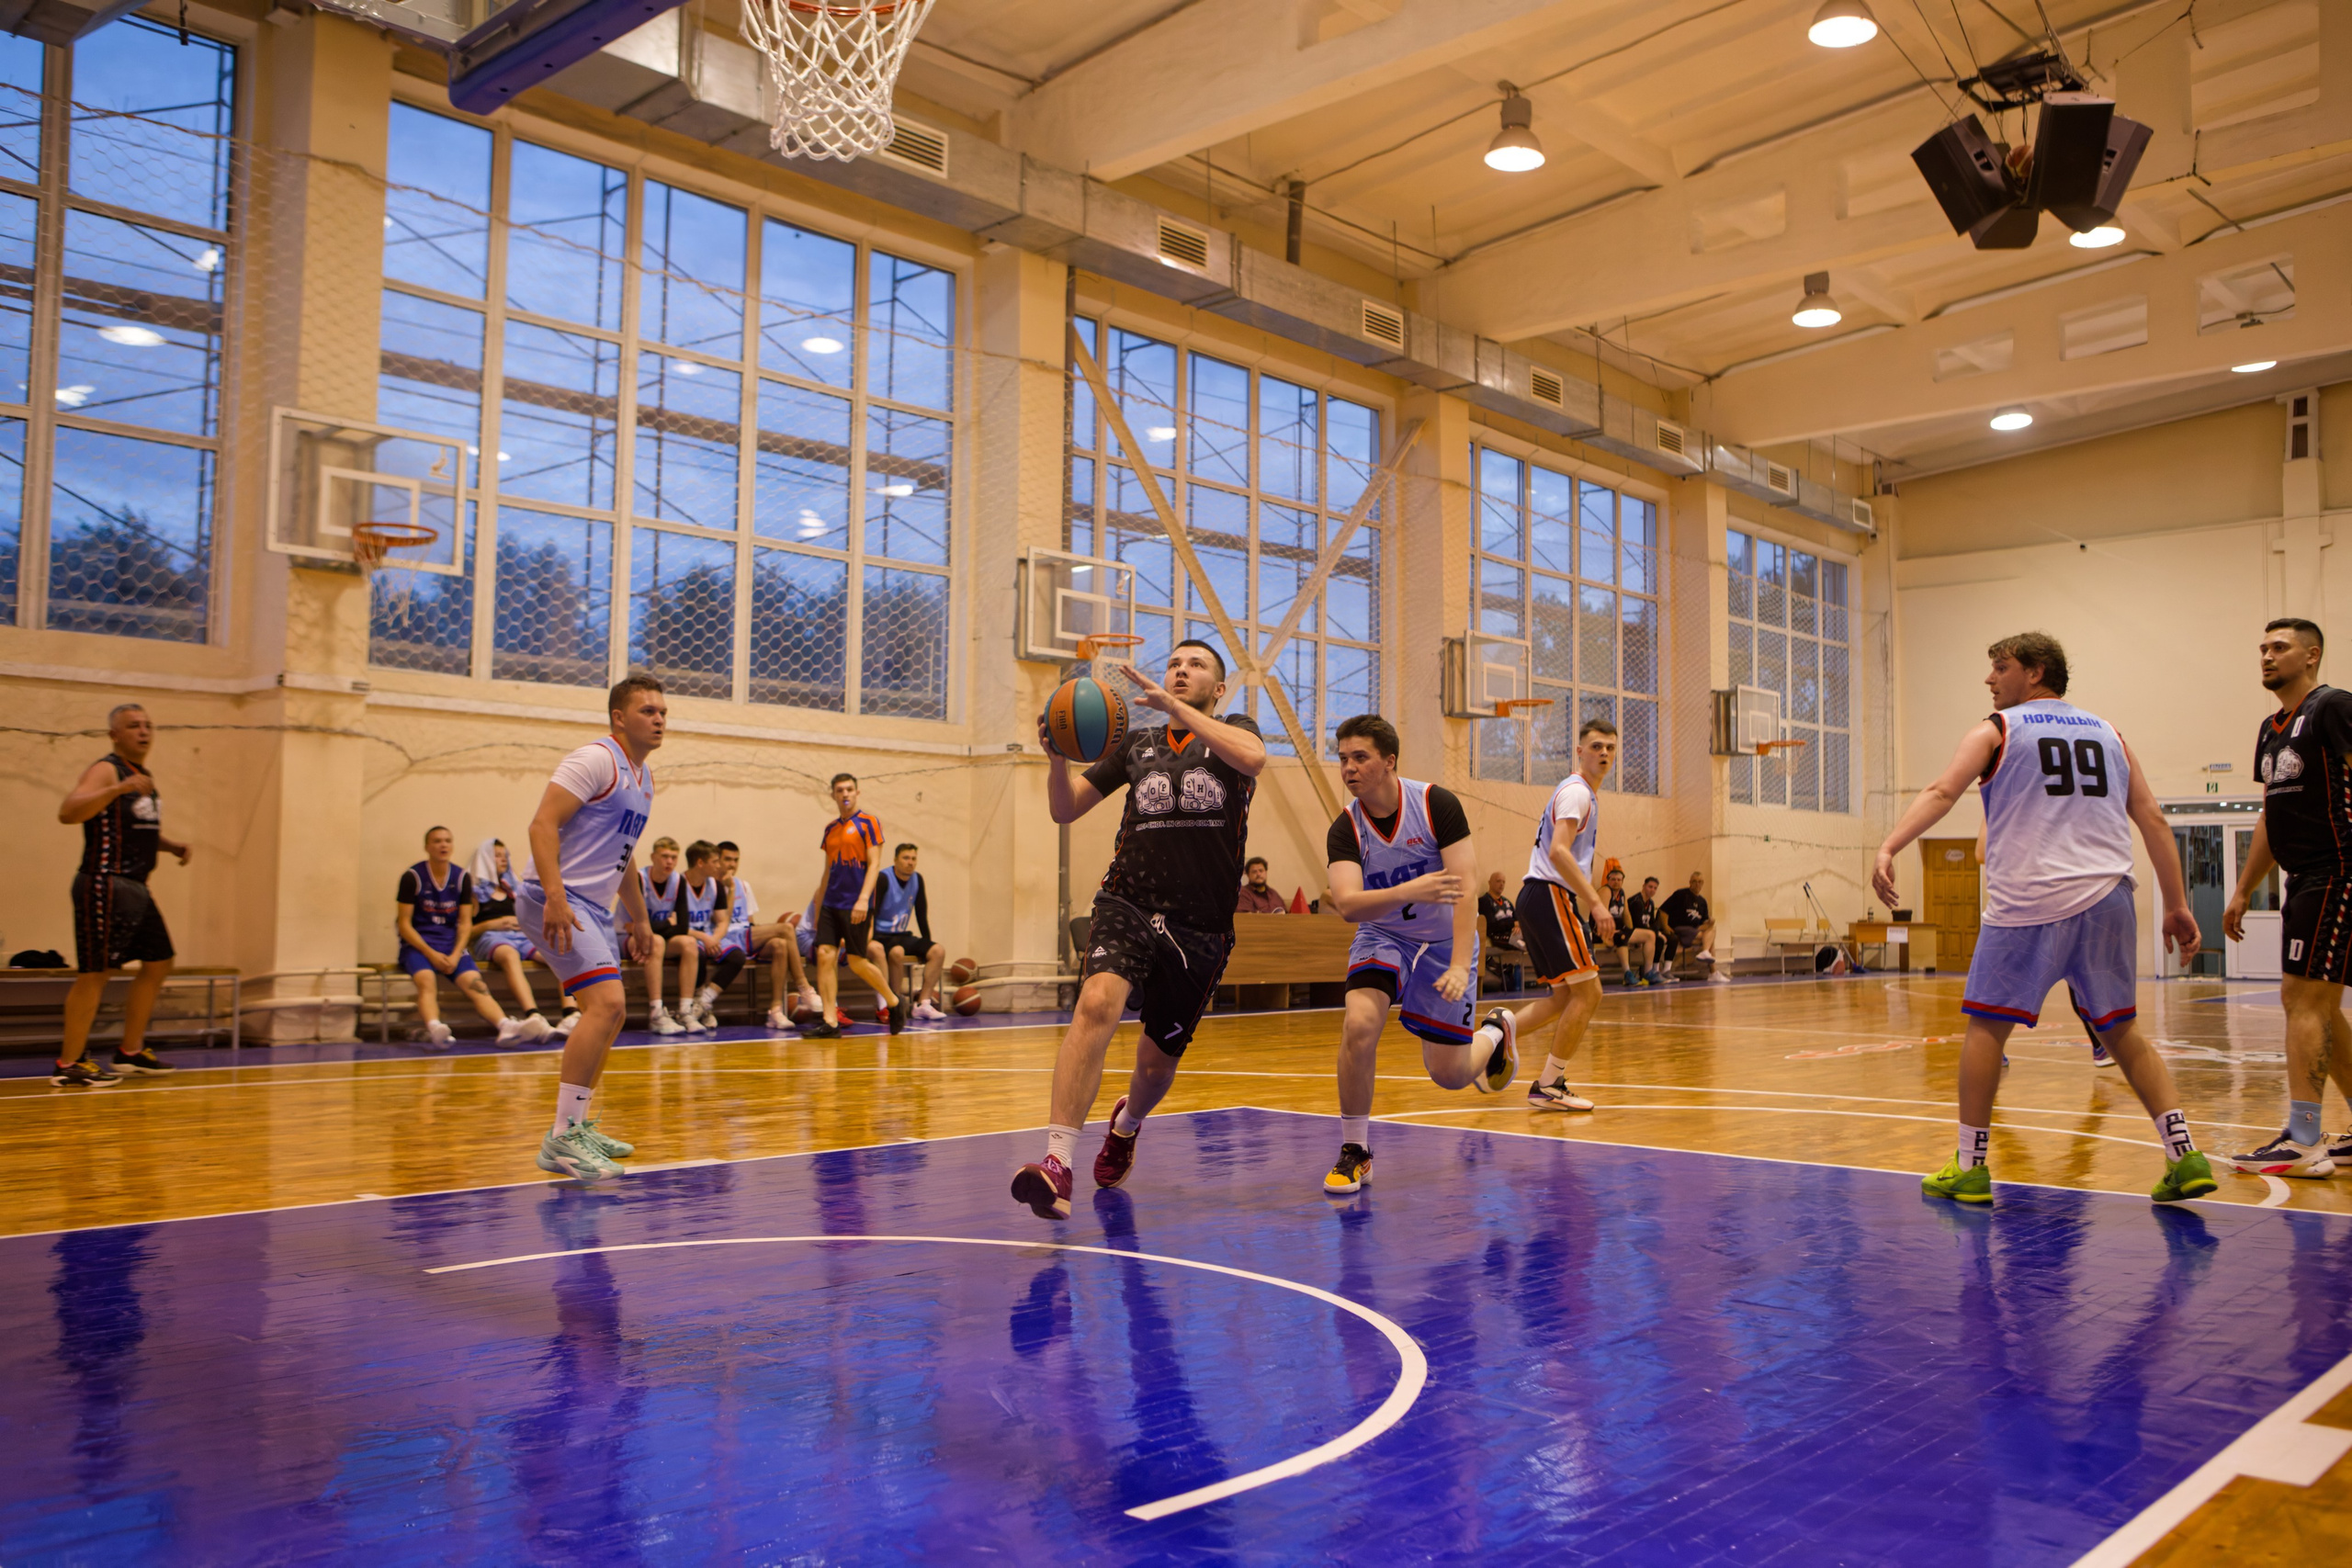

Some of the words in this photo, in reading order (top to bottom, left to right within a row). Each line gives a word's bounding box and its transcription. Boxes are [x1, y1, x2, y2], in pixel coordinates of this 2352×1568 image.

[1057, 709, 1068, 730] FIBA
[2022, 714, 2102, 729] НОРИЦЫН
[2038, 738, 2109, 797] 99
[2289, 938, 2304, 962] 10
[1462, 1002, 1473, 1026] 2
[1164, 1021, 1183, 1039] 7
